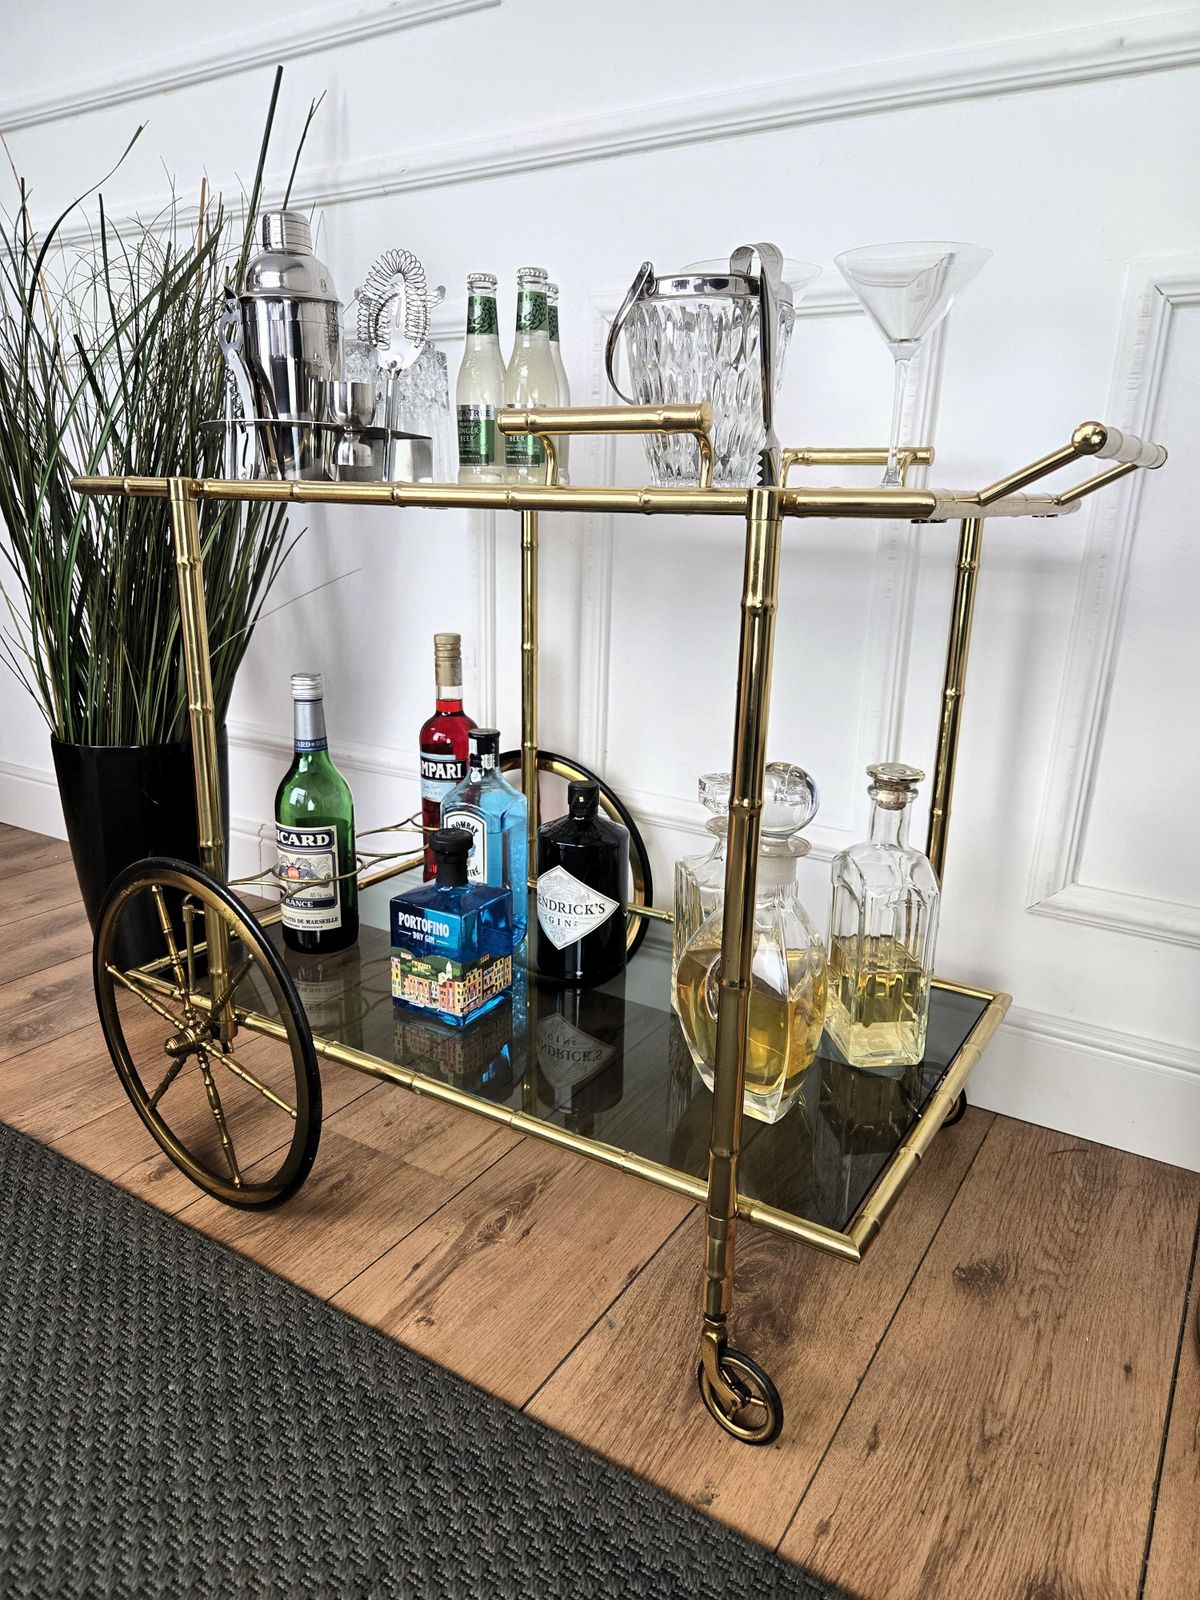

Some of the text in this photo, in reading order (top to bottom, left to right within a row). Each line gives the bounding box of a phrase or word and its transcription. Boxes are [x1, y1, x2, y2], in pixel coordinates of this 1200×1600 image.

[421, 760, 462, 779] MPARI
[451, 821, 479, 836] BOMBAY
[276, 830, 330, 847] ICARD
[285, 897, 314, 908] RANCE
[537, 894, 606, 915] ENDRICK'S
[398, 911, 450, 938] PORTOFINO
[549, 916, 572, 927] GIN
[412, 931, 436, 945] DRY GIN
